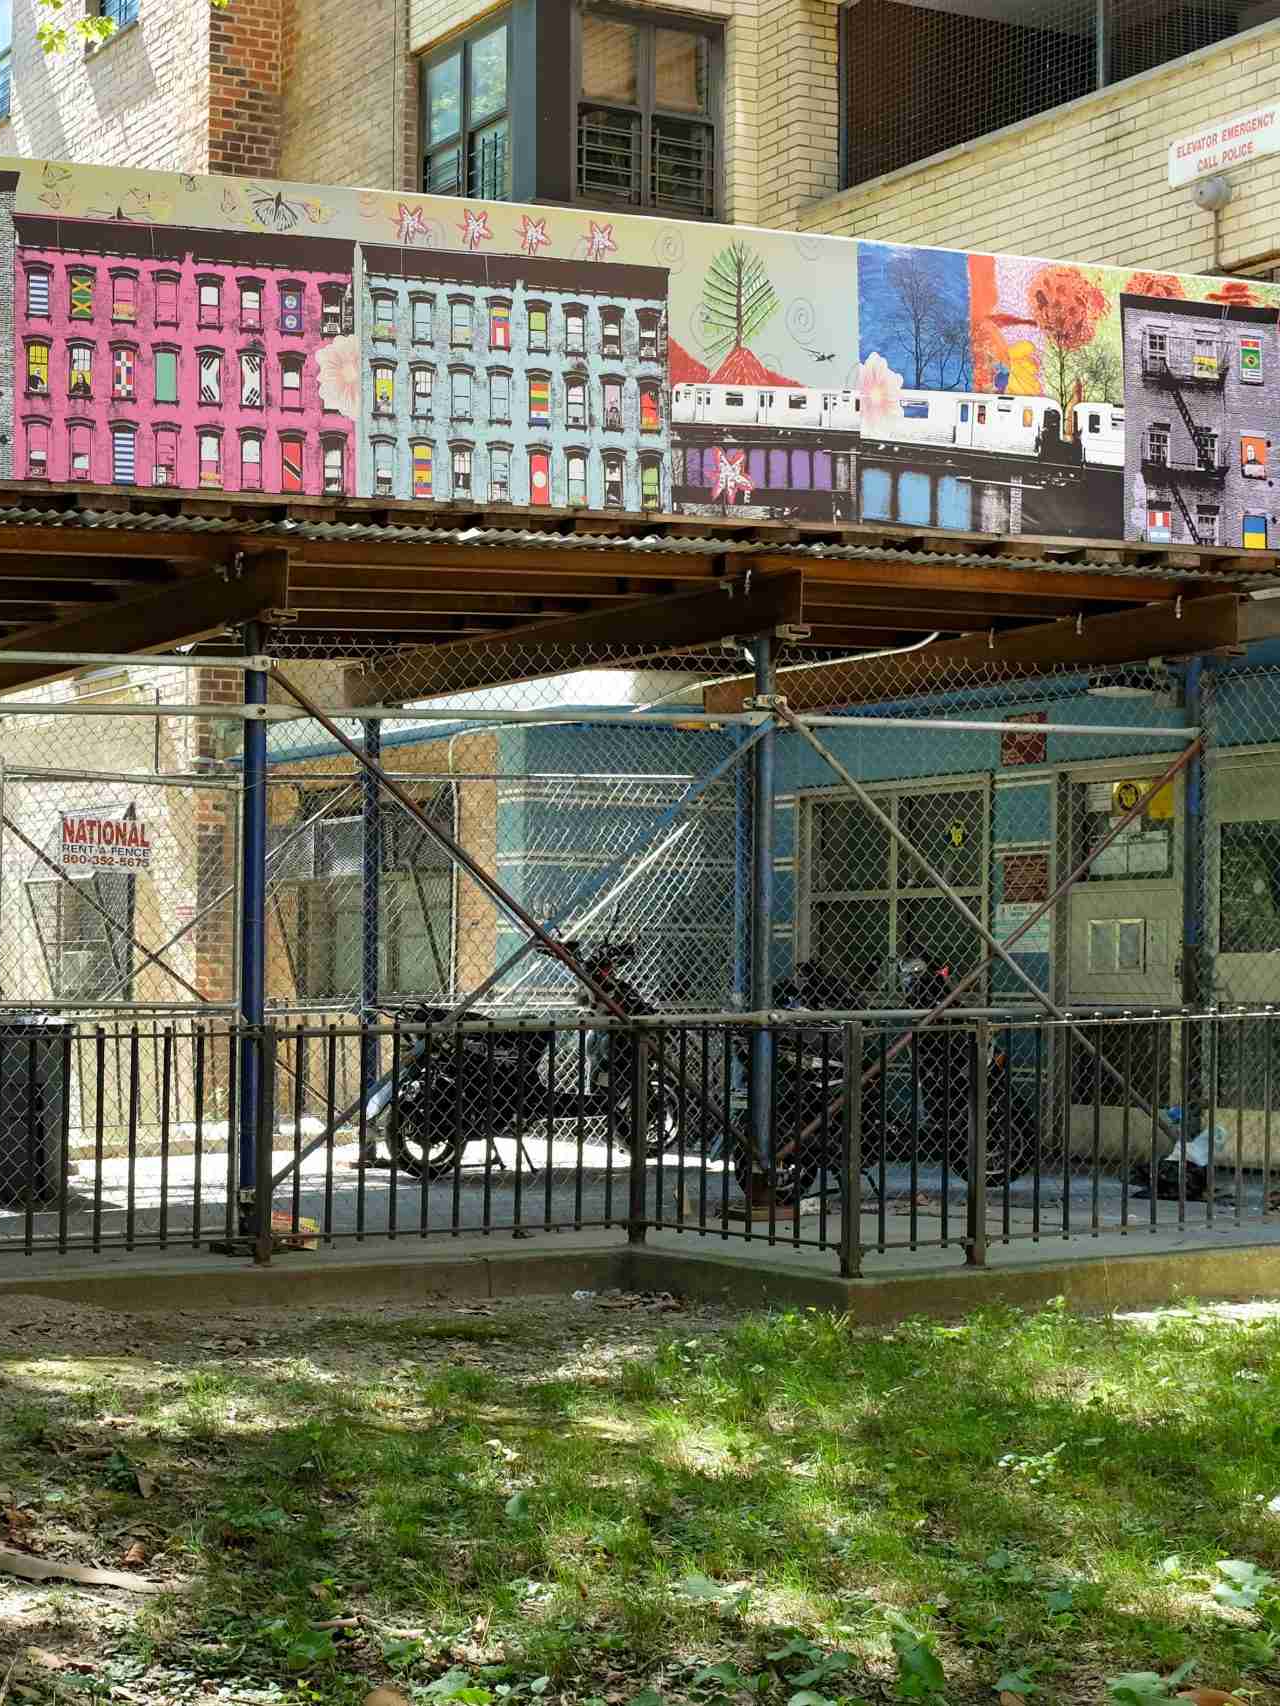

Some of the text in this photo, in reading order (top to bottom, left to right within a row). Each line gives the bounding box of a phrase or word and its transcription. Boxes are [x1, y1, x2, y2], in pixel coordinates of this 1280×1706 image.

[1176, 111, 1276, 159] ELEVATOR EMERGENCY
[1198, 141, 1254, 172] CALL POLICE
[63, 816, 149, 847] NATIONAL
[62, 844, 151, 857] RENT-A-FENCE
